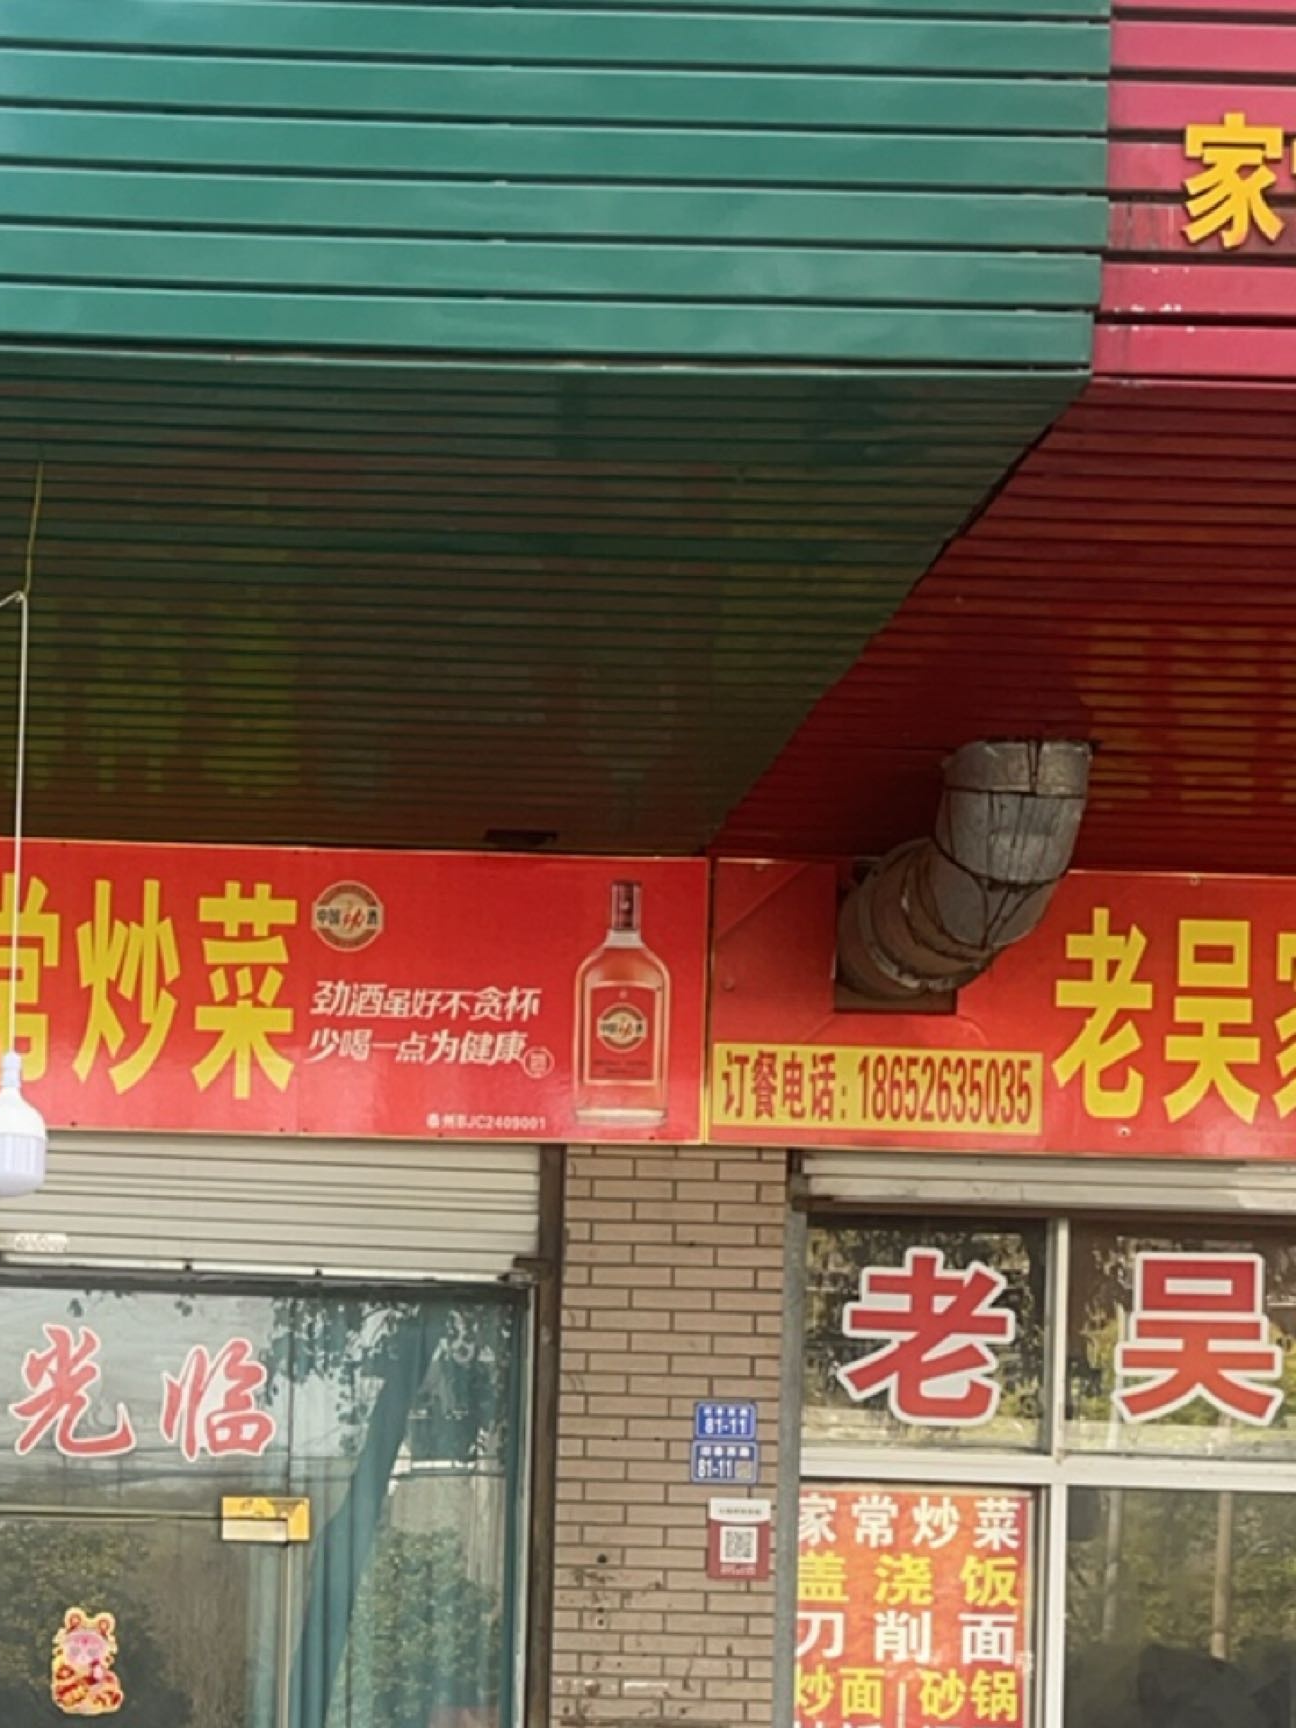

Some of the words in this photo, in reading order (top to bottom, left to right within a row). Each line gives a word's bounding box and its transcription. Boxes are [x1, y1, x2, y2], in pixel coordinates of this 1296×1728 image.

[1182, 111, 1296, 249] 家
[309, 979, 543, 1022] 劲酒虽好不贪杯
[1053, 907, 1296, 1125] 老吴
[305, 1027, 528, 1066] 少喝一点为健康
[799, 1493, 1021, 1550] 家常炒菜
[798, 1551, 1018, 1607] 盖浇饭
[796, 1609, 1018, 1665] 刀削面
[919, 1668, 1018, 1722] 砂锅
